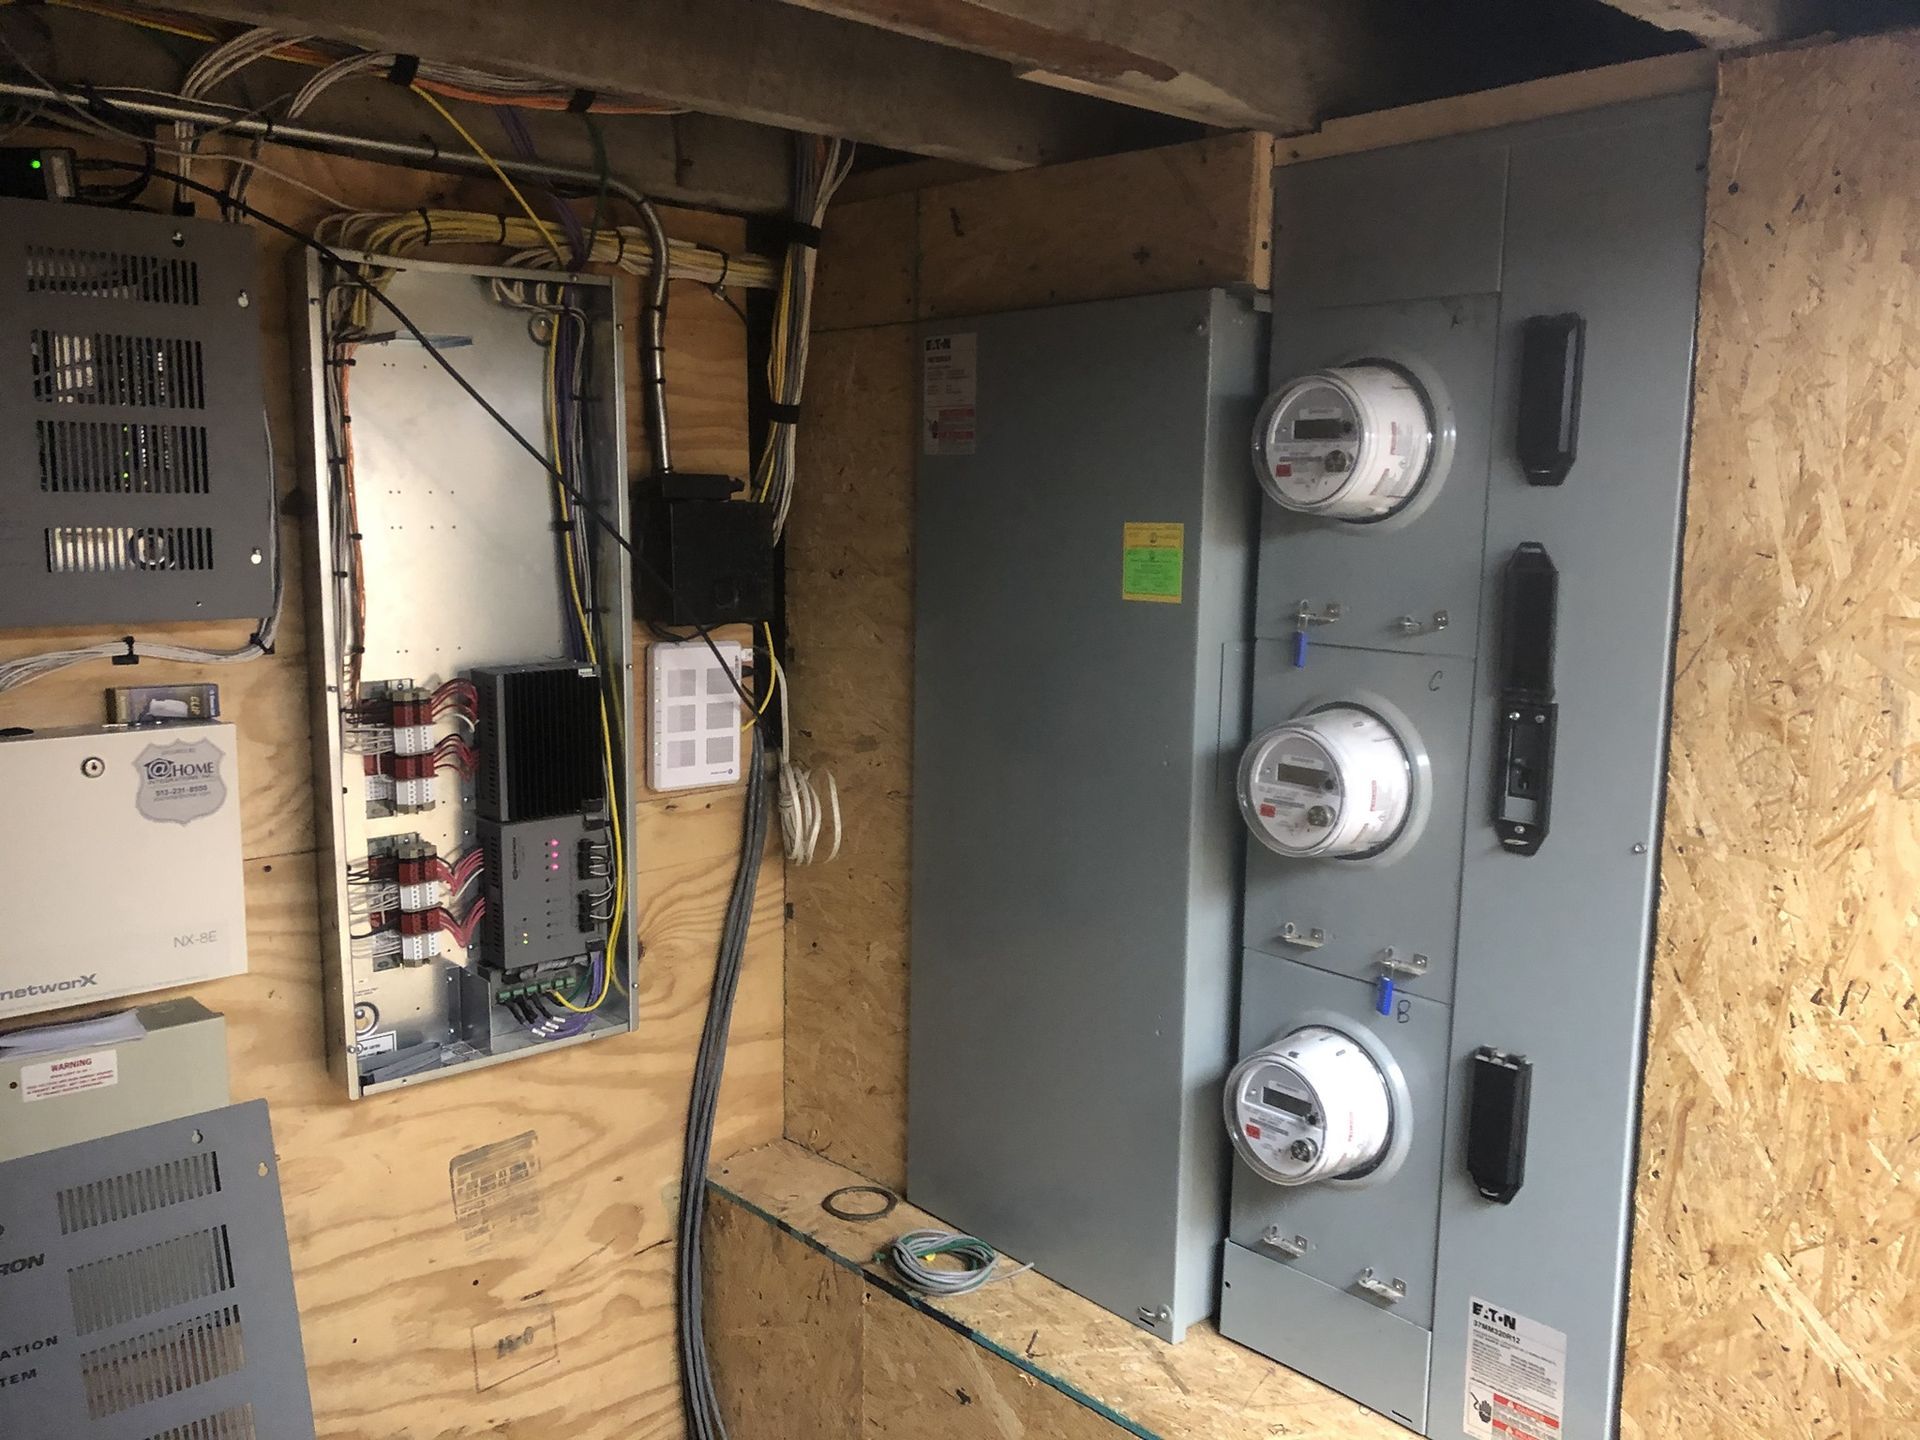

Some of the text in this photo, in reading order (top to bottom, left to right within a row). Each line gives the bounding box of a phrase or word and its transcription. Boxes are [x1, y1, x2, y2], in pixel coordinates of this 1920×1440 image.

[1428, 670, 1443, 691] C
[145, 758, 214, 779] @HOME
[173, 930, 218, 949] NX-8E
[0, 973, 97, 1001] networX
[1397, 1000, 1412, 1024] B
[51, 1058, 93, 1073] WARNING
